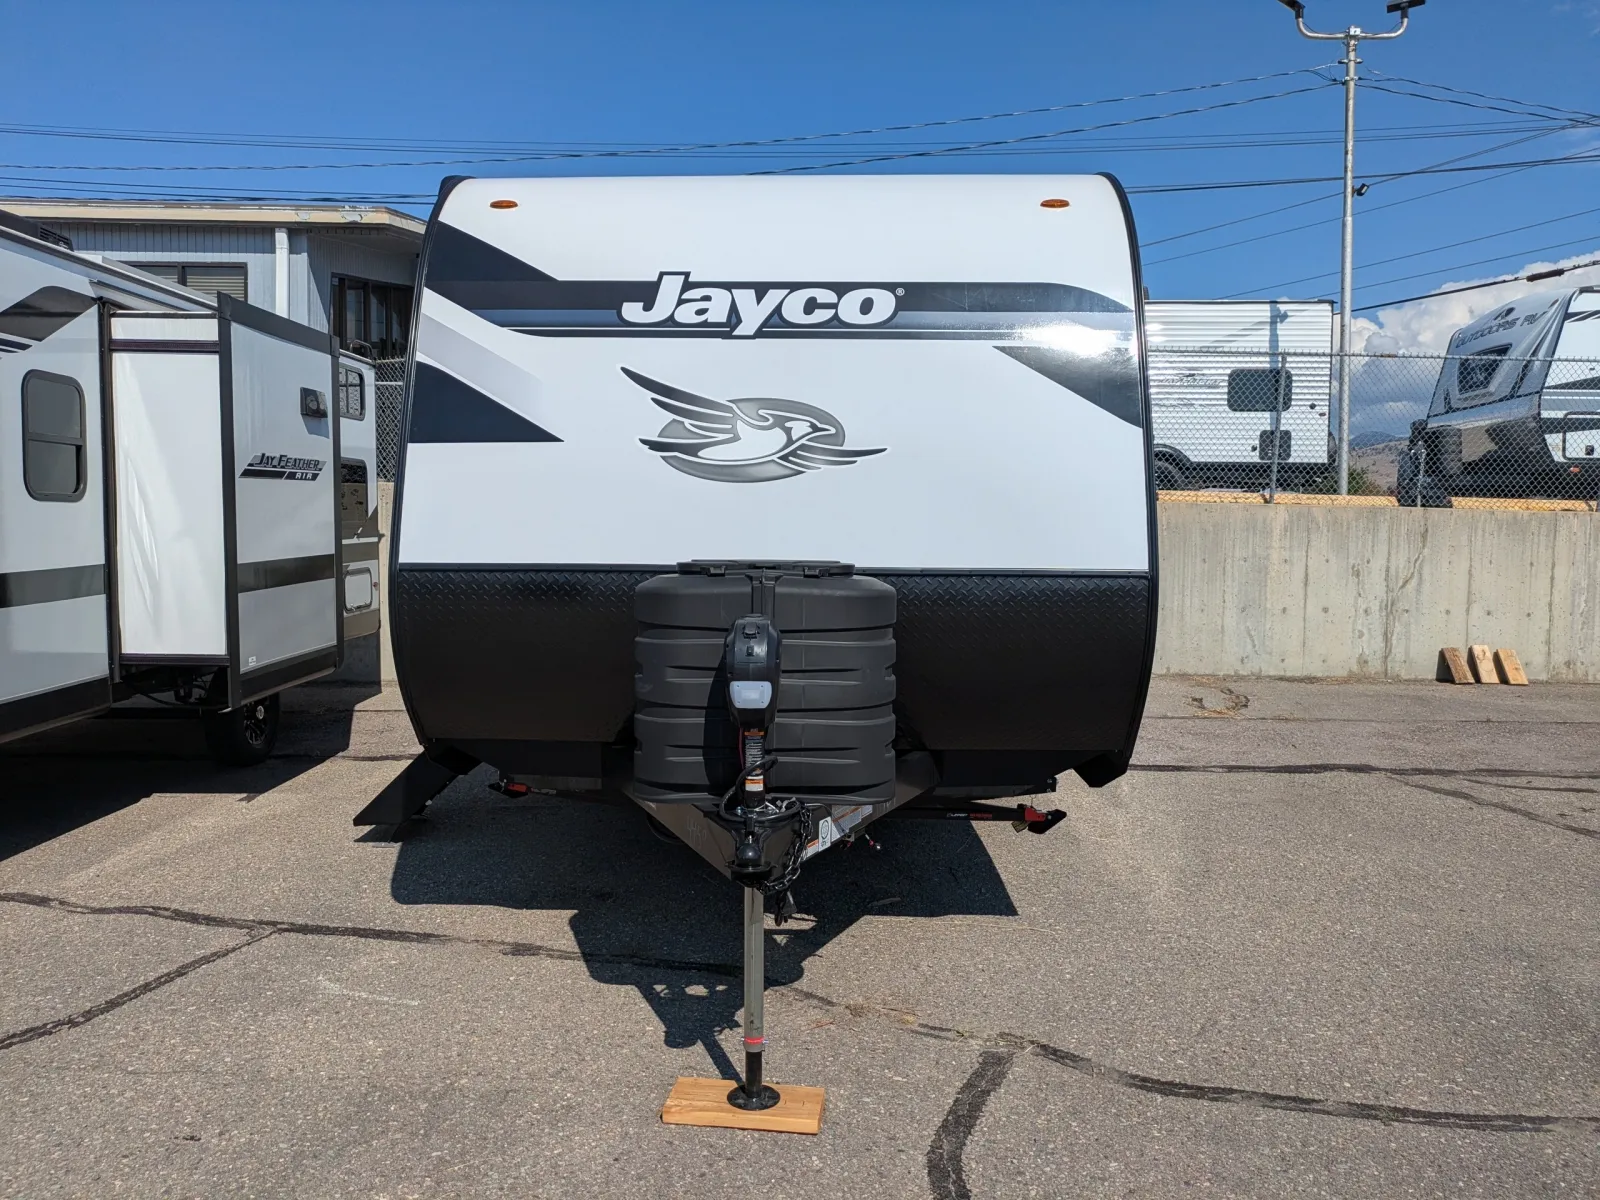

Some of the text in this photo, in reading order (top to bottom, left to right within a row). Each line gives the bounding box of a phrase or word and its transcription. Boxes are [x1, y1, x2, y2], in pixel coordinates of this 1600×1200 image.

[253, 453, 320, 470] JAY FEATHER
[295, 472, 313, 480] AIR
